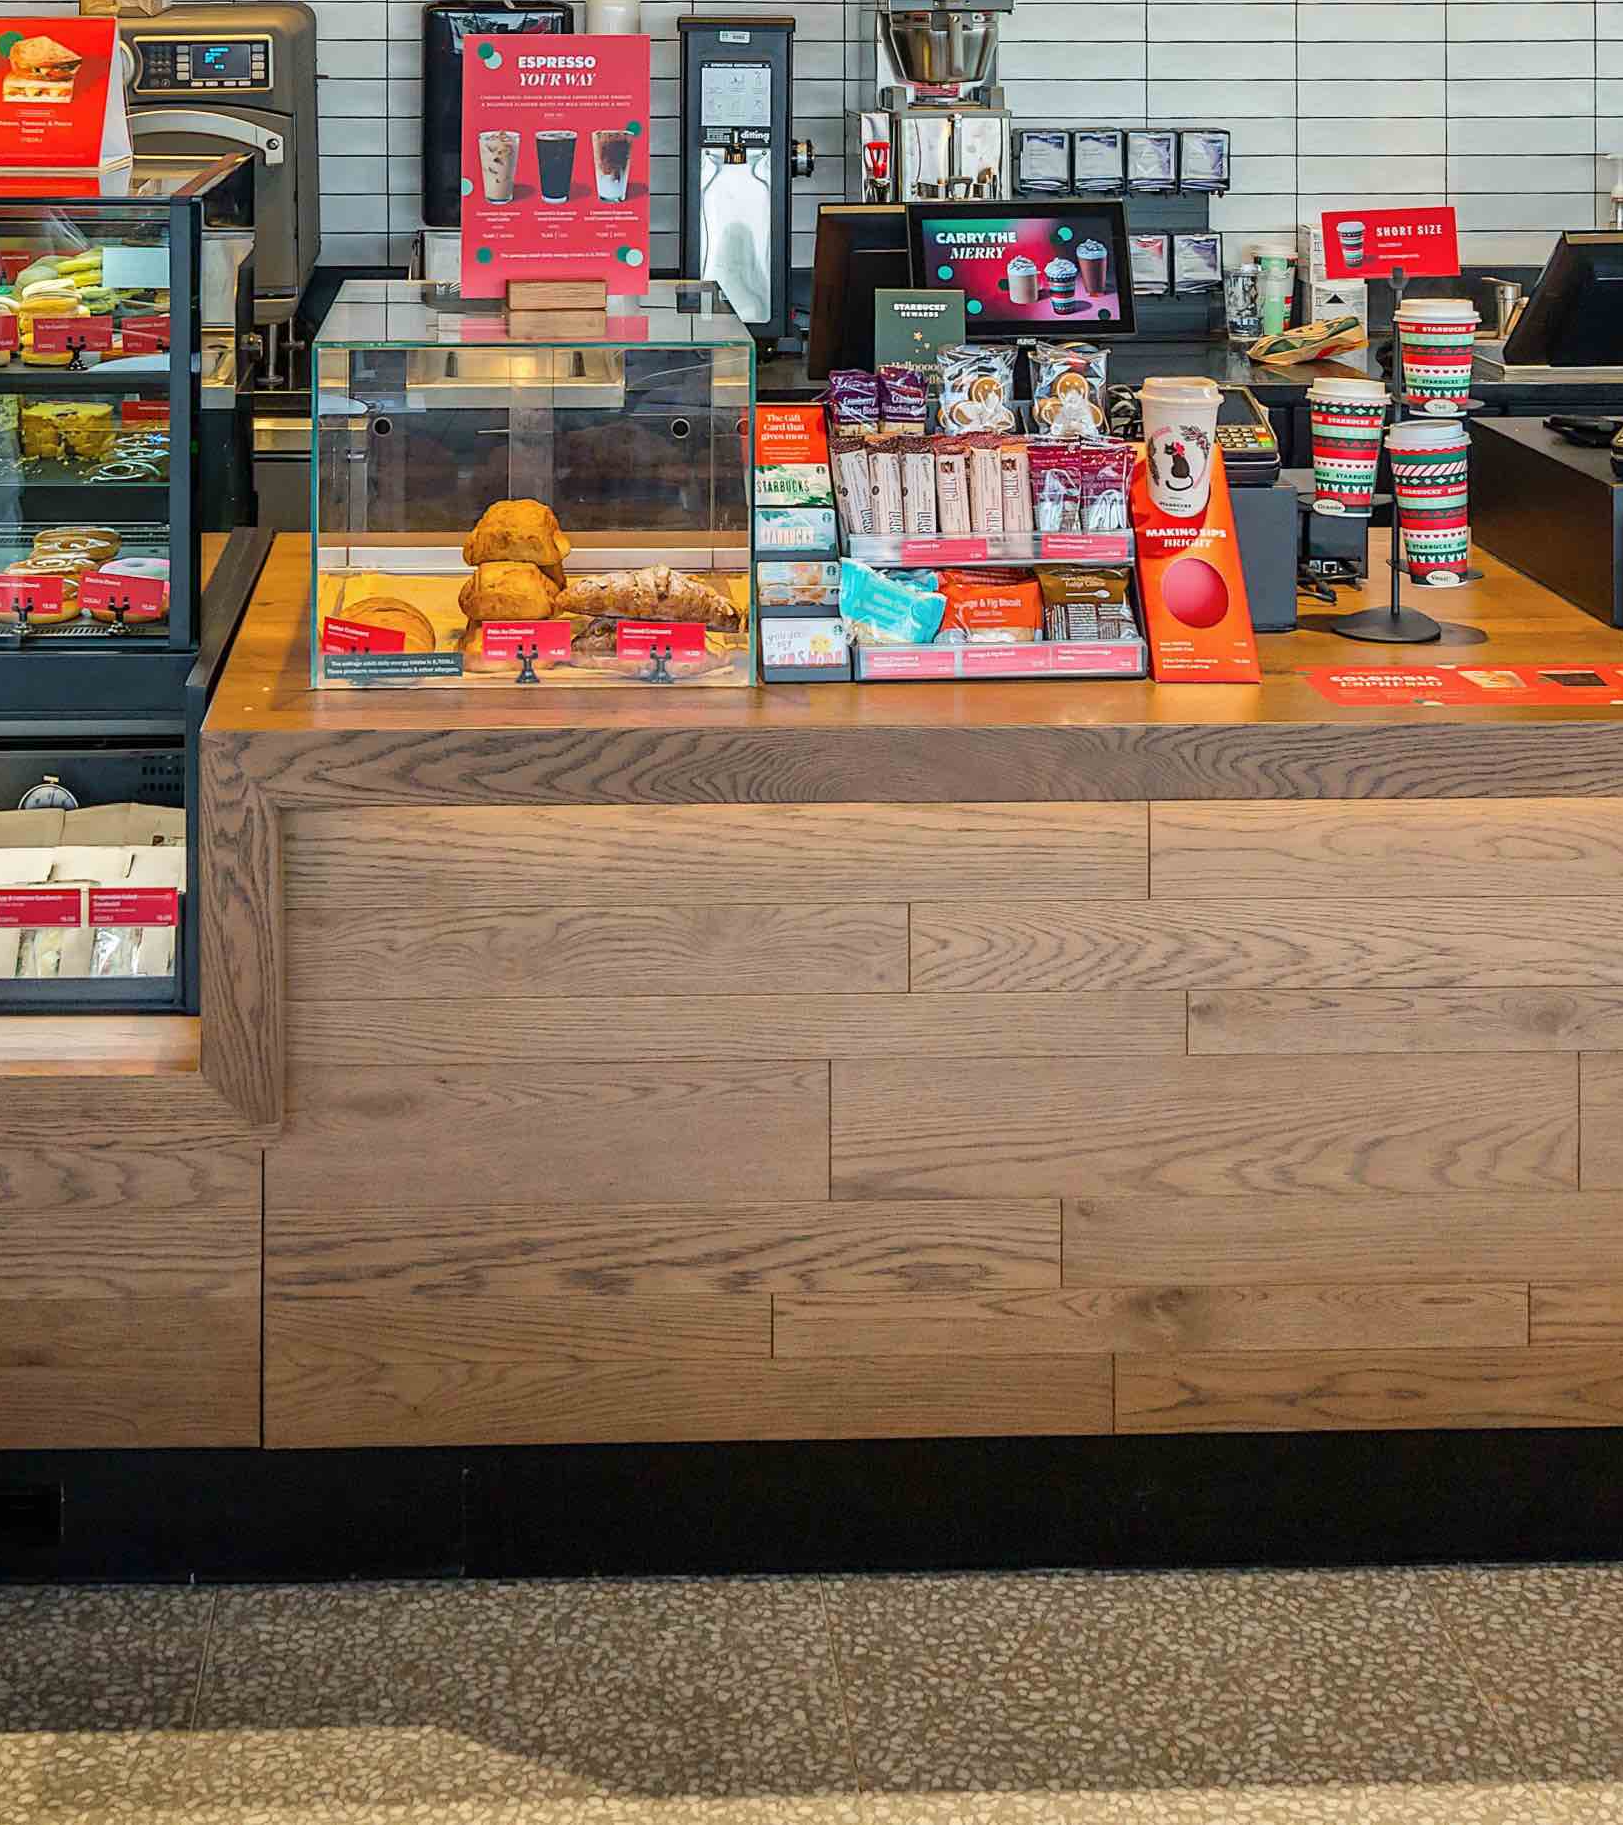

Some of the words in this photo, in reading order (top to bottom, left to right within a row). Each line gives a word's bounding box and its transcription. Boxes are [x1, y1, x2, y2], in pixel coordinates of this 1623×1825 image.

[518, 56, 596, 68] ESPRESSO
[519, 73, 560, 86] YOUR
[565, 73, 597, 86] WAY
[1376, 225, 1413, 237] SHORT
[1417, 224, 1443, 235] SIZE
[935, 231, 985, 244] CARRY
[987, 231, 1017, 244] THE
[950, 247, 1007, 260] MERRY
[893, 303, 946, 311] STARBUCKS
[1422, 325, 1467, 333] STARBUCKS
[766, 414, 783, 422] The
[784, 414, 801, 422] Gift
[1328, 417, 1370, 426] STARBUCKS
[763, 423, 785, 431] Card
[787, 423, 805, 431] that
[761, 433, 784, 441] gives
[755, 480, 810, 494] STARBUCKS
[1146, 528, 1198, 538] MAKING
[1199, 529, 1227, 538] SIPS
[1163, 538, 1214, 549] BRIGHT
